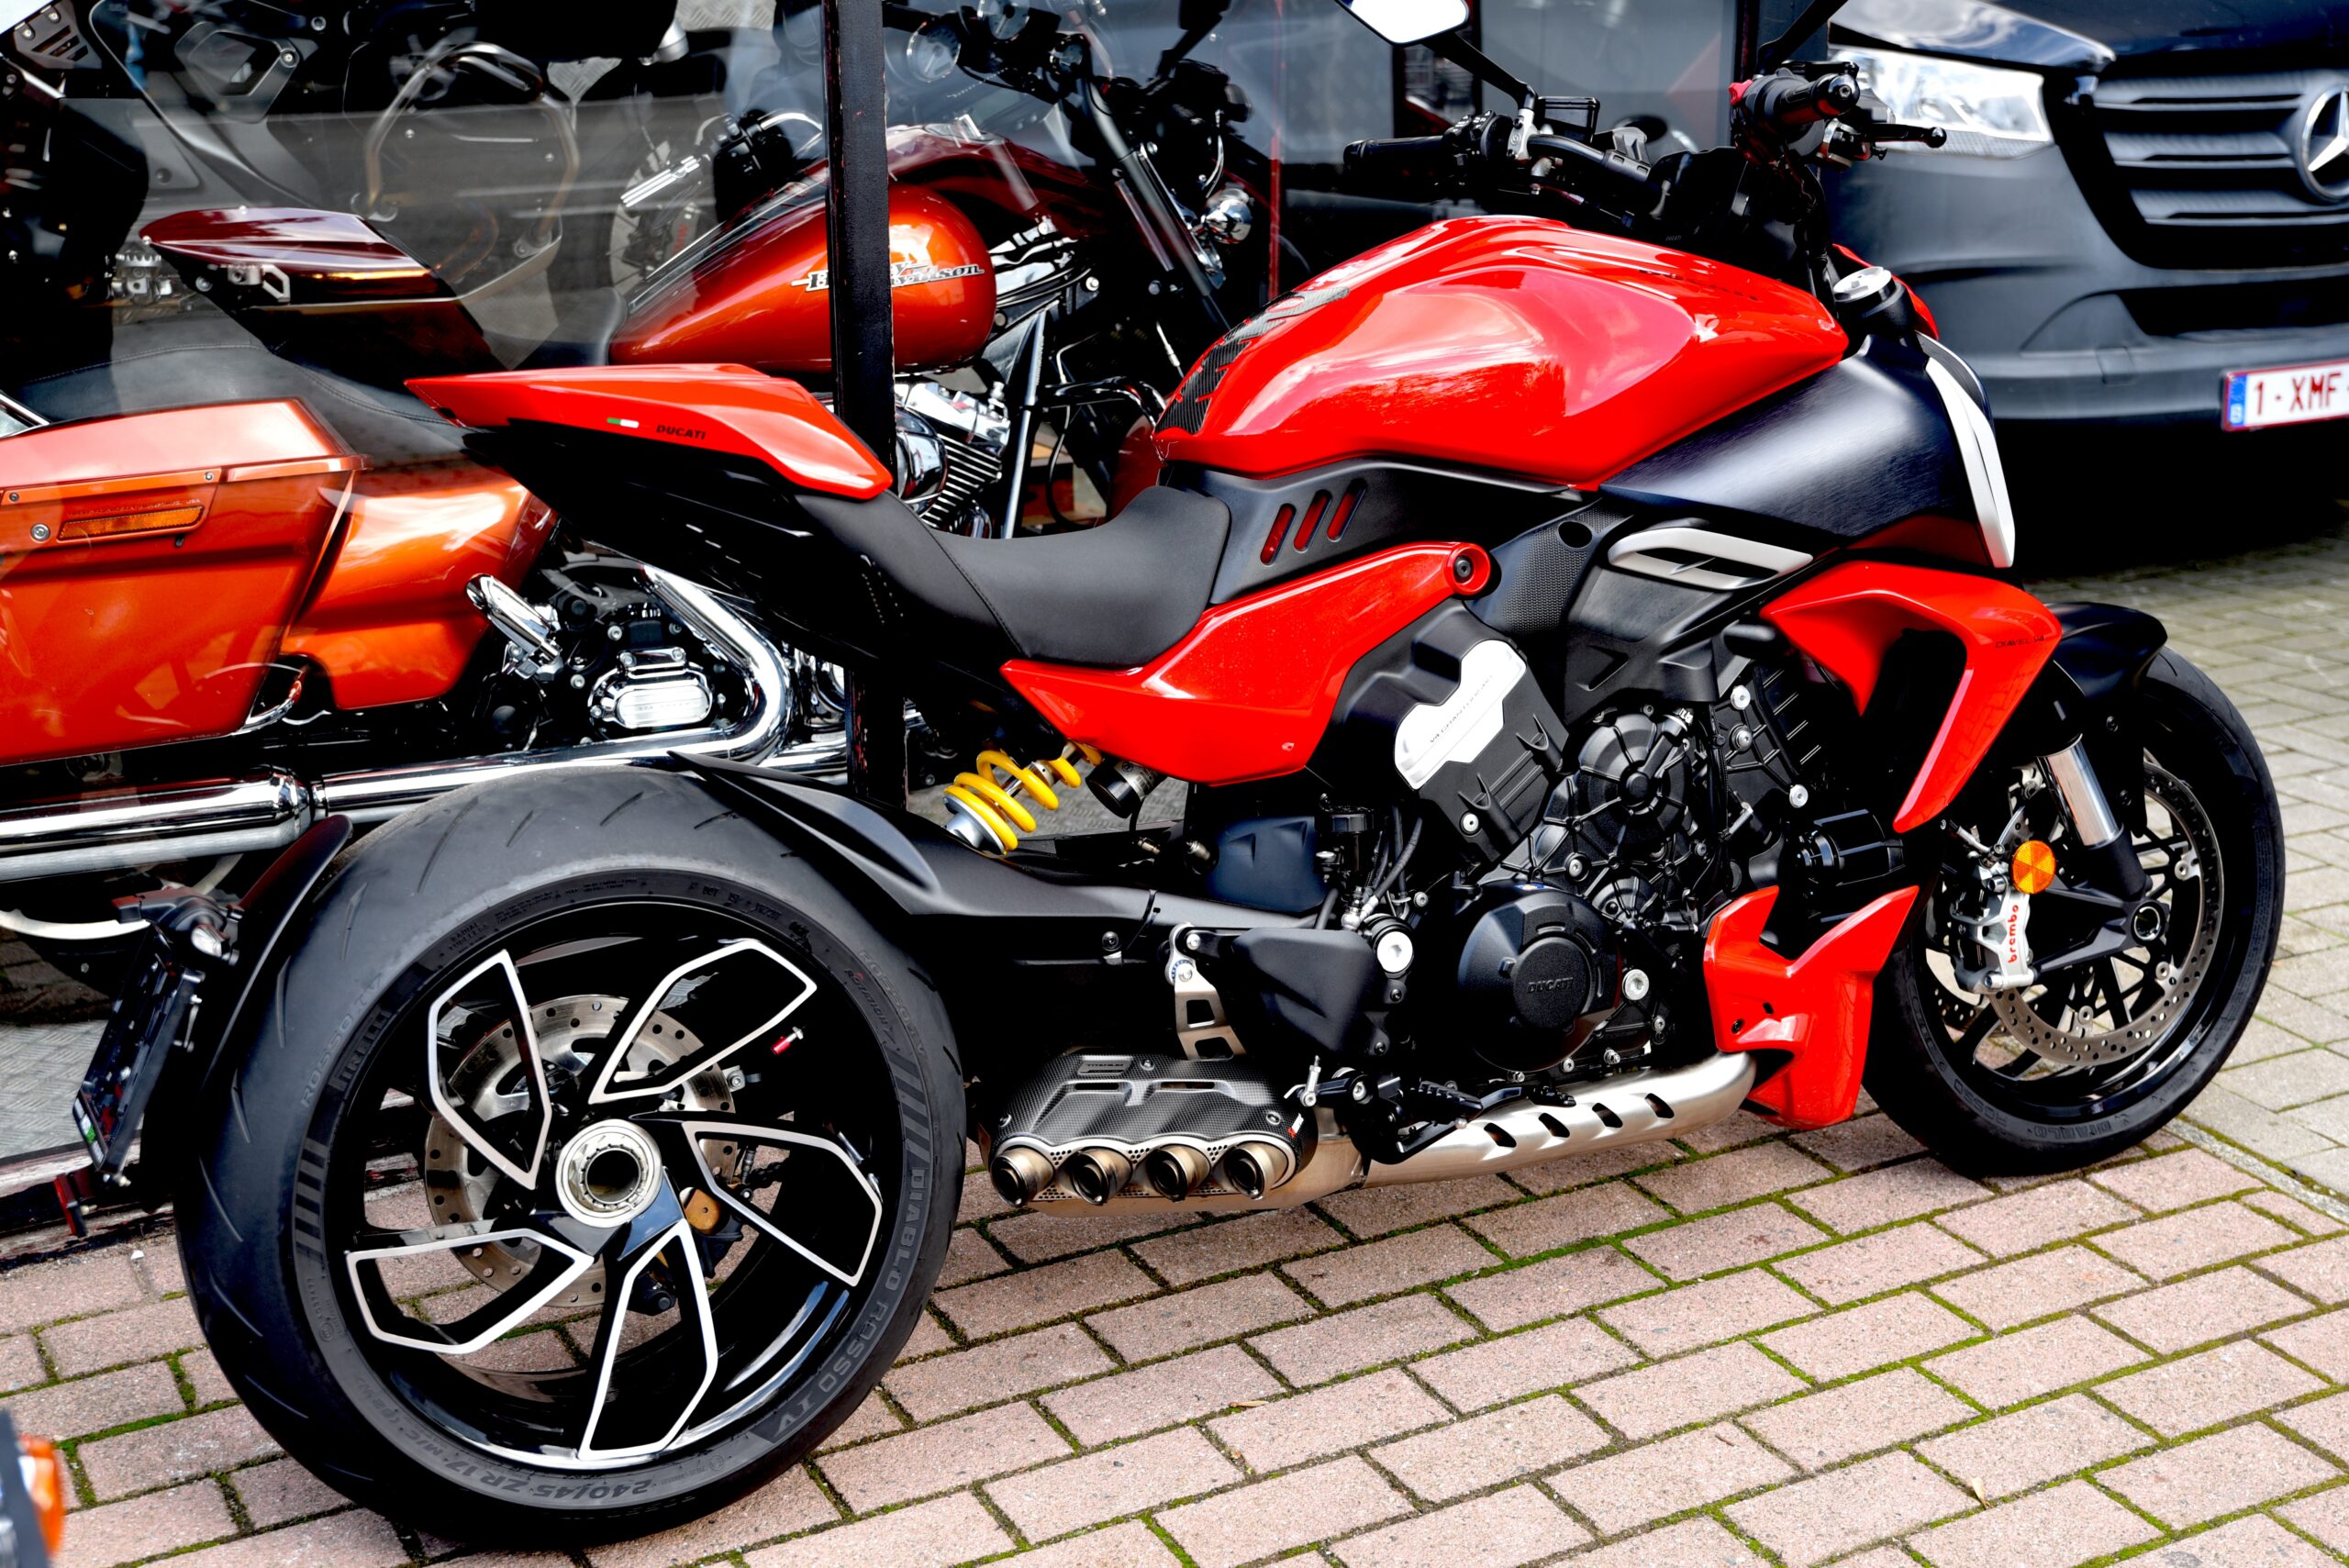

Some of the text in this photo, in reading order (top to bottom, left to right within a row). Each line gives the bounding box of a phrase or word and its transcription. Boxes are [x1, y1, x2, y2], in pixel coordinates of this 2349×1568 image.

[656, 425, 706, 439] DUCATI
[1995, 639, 2032, 648] DIAVEL
[2007, 905, 2019, 964] brembo
[844, 969, 889, 1025] ROTATION
[1527, 976, 1574, 994] DUCATI
[301, 1013, 354, 1107] ROSSO
[1954, 1079, 2112, 1140] DIABLO ROSSO
[776, 1167, 928, 1434] DIABLO ROSSO IV
[405, 1429, 444, 1456] M/C
[446, 1461, 482, 1476] 17
[480, 1470, 529, 1492] ZR
[533, 1478, 653, 1500] 240/45
